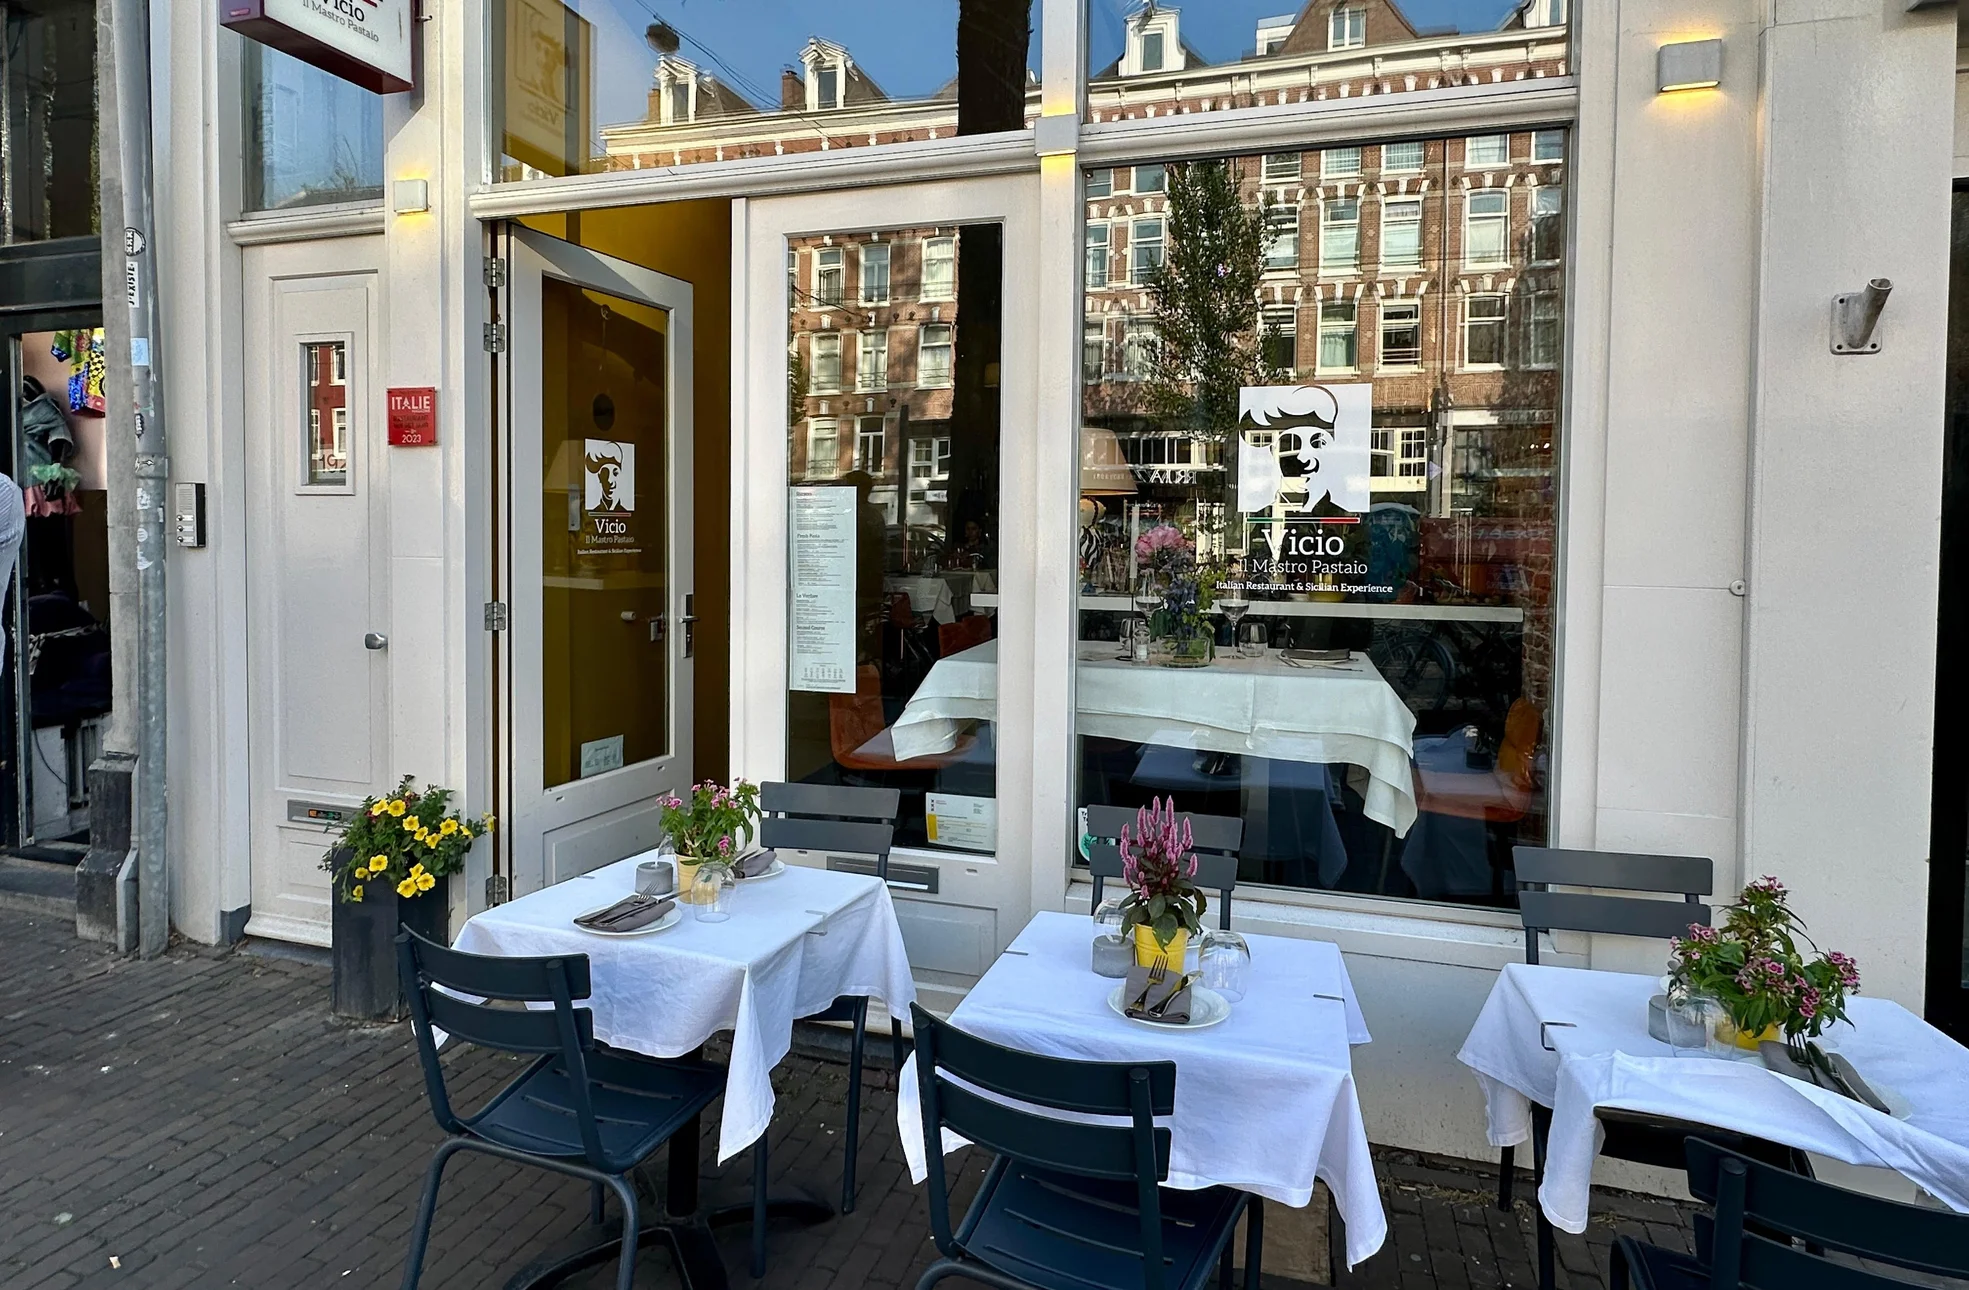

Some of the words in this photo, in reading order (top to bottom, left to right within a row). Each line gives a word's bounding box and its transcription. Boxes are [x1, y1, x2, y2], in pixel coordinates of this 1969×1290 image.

[323, 0, 366, 22] icio
[311, 1, 346, 26] Mastro
[348, 19, 379, 42] Pastaio
[391, 396, 431, 410] ITALIE
[401, 434, 422, 444] 2023
[595, 519, 626, 533] Vicio
[591, 535, 613, 543] Mastro
[1261, 528, 1345, 557] Vicio
[1238, 558, 1249, 573] Il
[1252, 558, 1308, 574] Mastro
[1311, 559, 1369, 575] Pastaio
[1215, 580, 1245, 590] Italian
[1246, 580, 1295, 591] Restaurant
[1296, 582, 1303, 591] &
[1305, 582, 1340, 592] Sicilian
[1340, 583, 1394, 593] Experience
